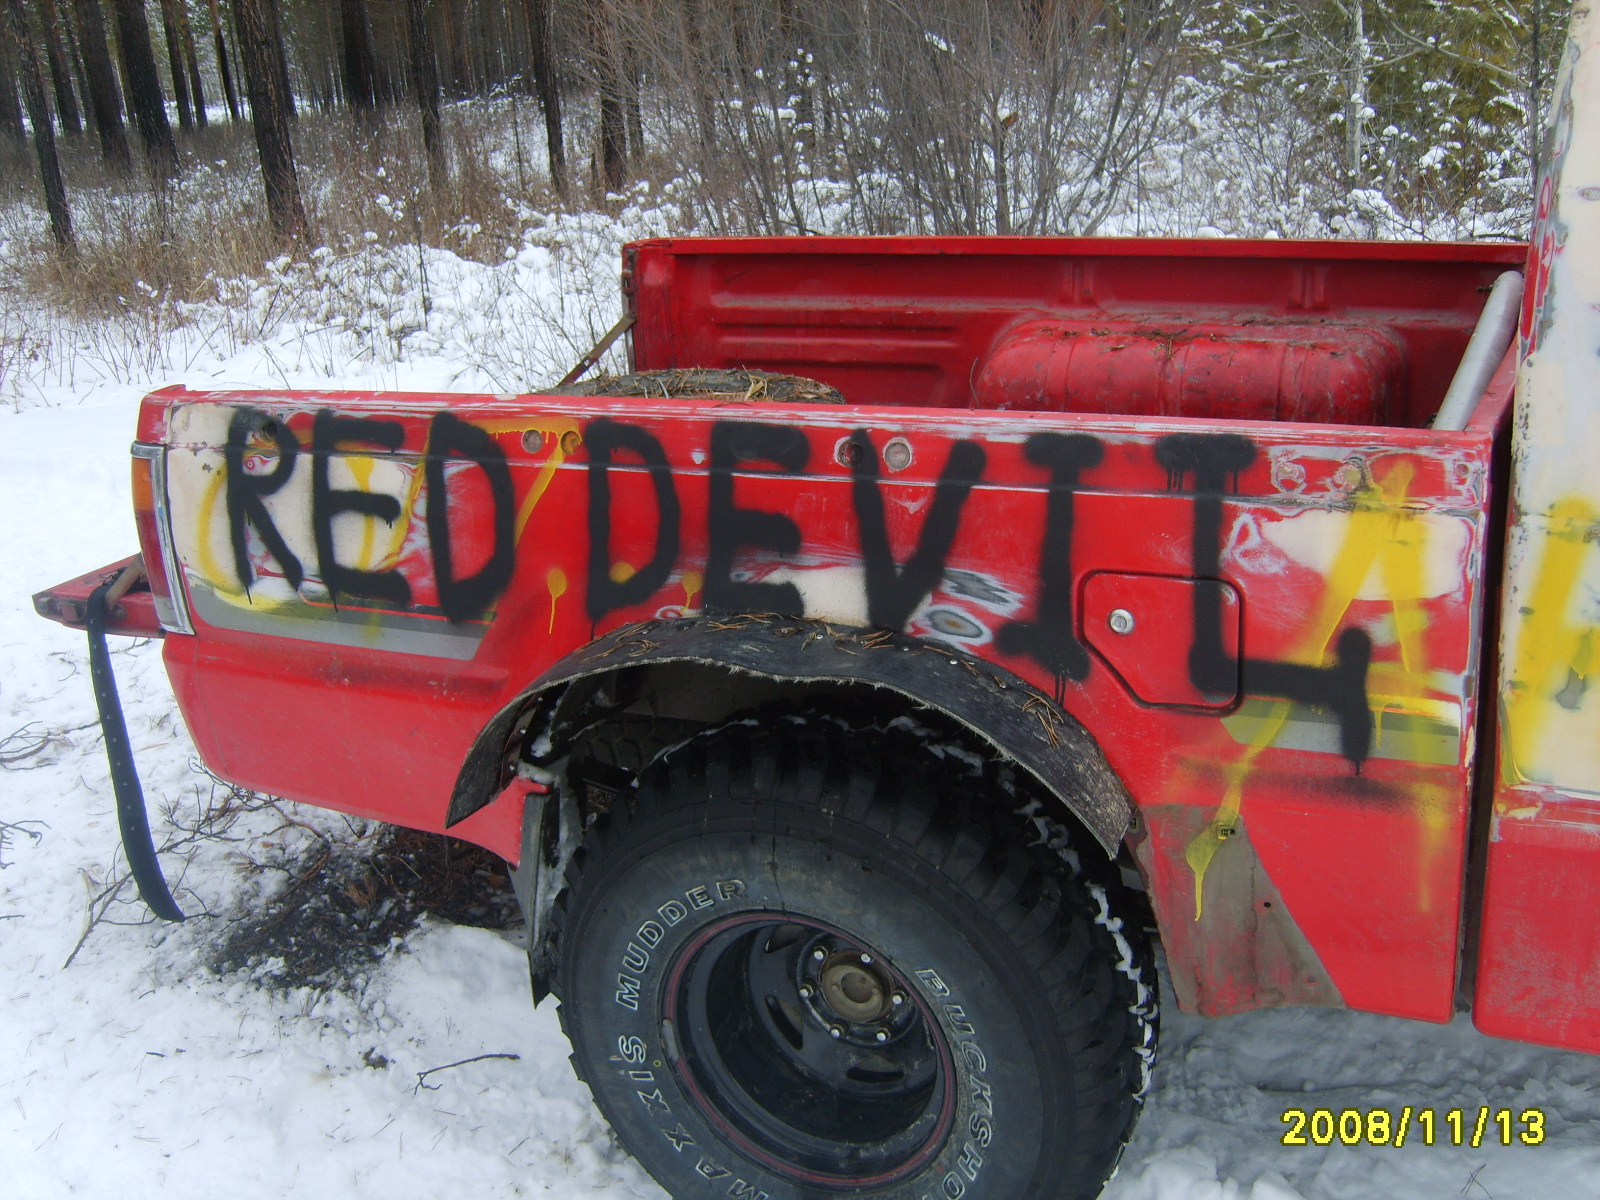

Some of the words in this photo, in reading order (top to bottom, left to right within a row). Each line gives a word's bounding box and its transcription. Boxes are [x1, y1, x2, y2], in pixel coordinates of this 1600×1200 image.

[225, 405, 515, 626] RED
[583, 415, 1373, 770] DEVIL
[616, 879, 746, 1010] MUDDER
[915, 968, 993, 1200] BUCKSHO
